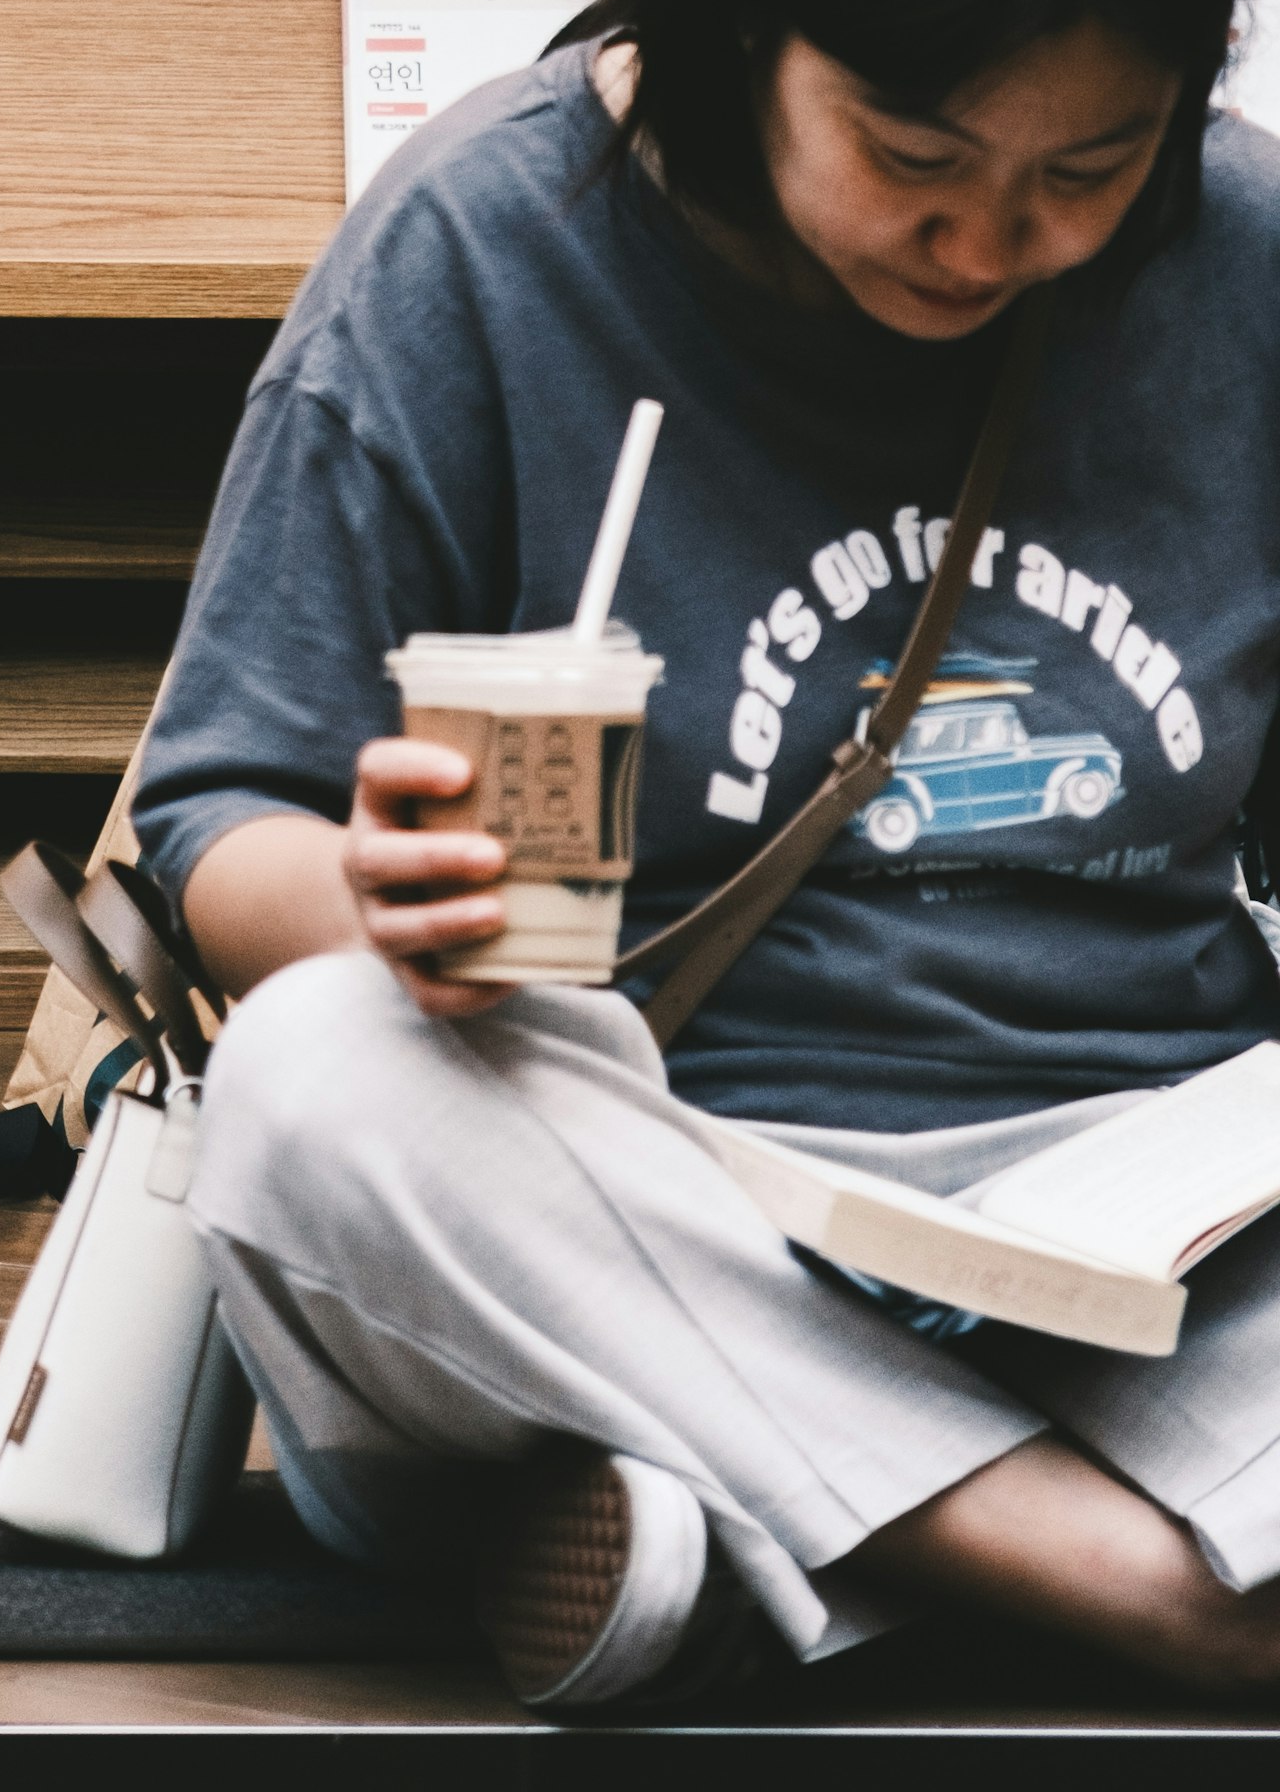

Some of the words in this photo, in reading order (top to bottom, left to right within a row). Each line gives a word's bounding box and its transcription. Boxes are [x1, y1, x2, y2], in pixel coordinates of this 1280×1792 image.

[367, 61, 423, 92] 연인
[700, 581, 825, 828] Let's
[808, 527, 894, 622] go
